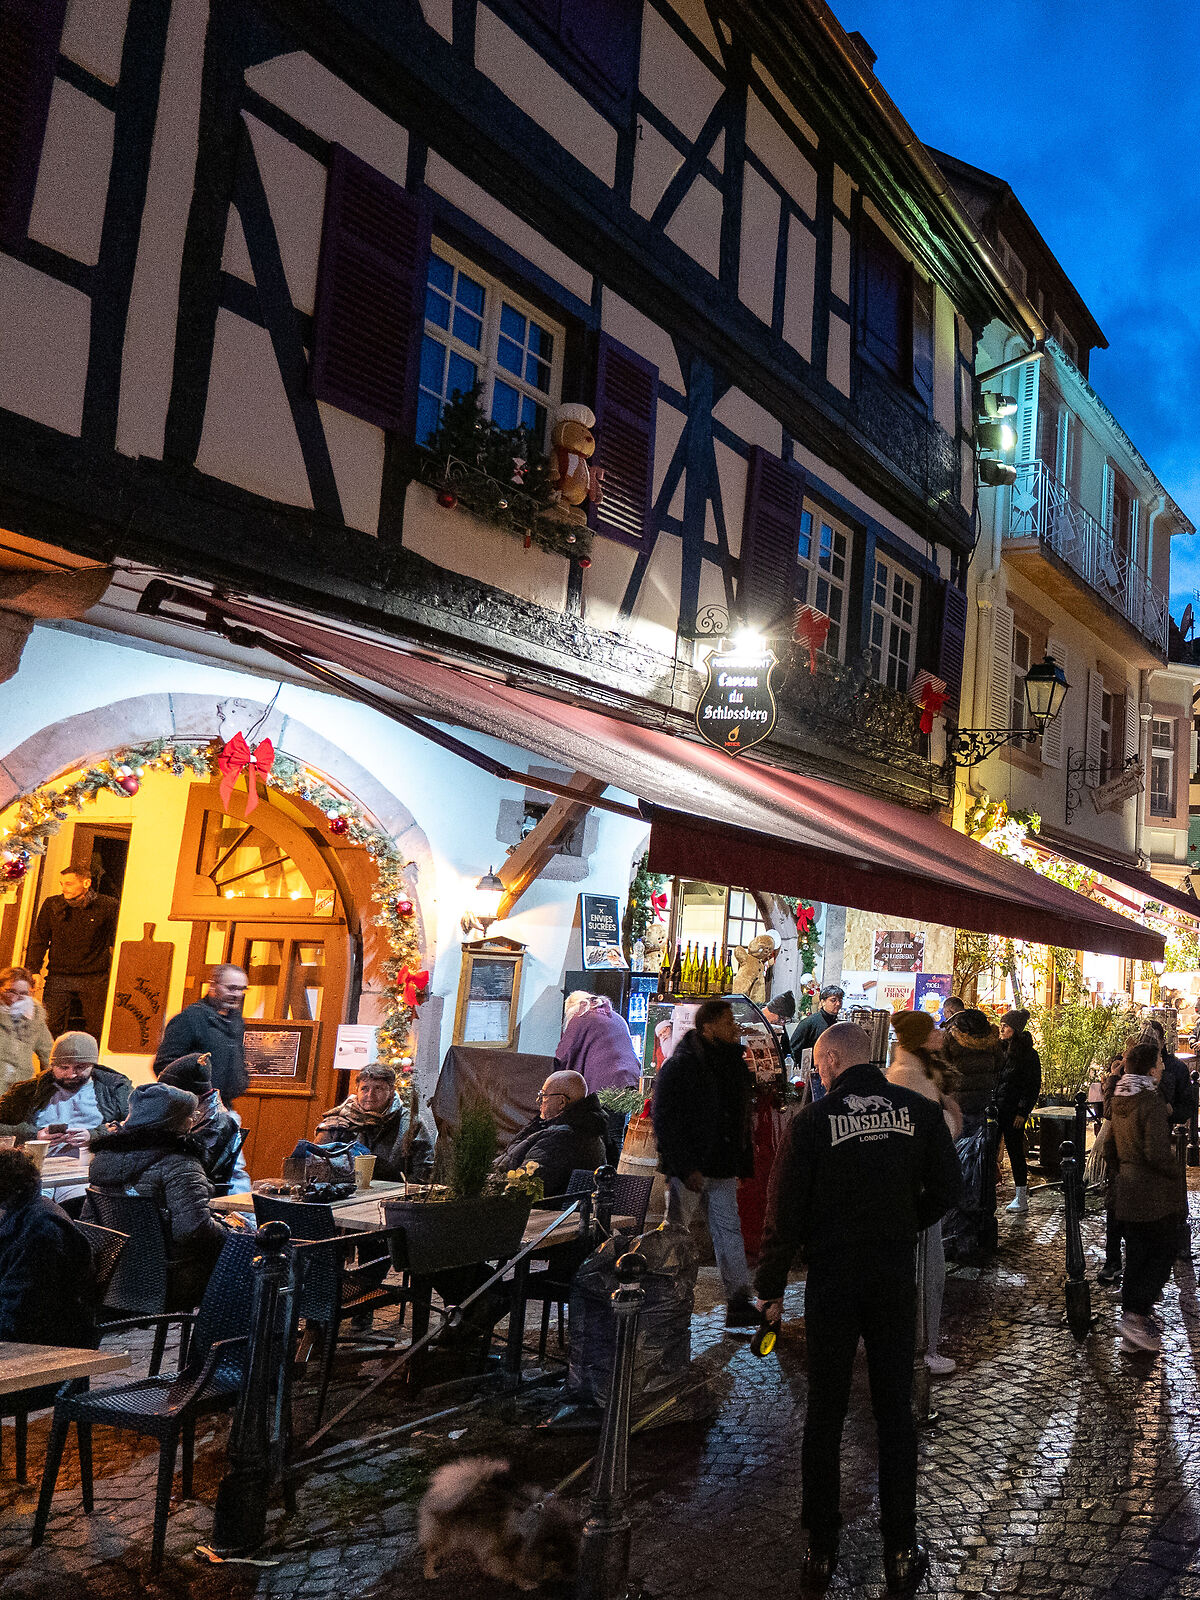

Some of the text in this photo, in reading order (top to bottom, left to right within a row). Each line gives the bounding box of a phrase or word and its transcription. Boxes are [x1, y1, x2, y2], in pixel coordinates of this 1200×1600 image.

[728, 689, 743, 703] du
[703, 705, 768, 723] Schlossberg
[591, 914, 613, 923] ENVIES
[828, 1107, 914, 1146] LONSDALE
[860, 1133, 889, 1142] LONDON
